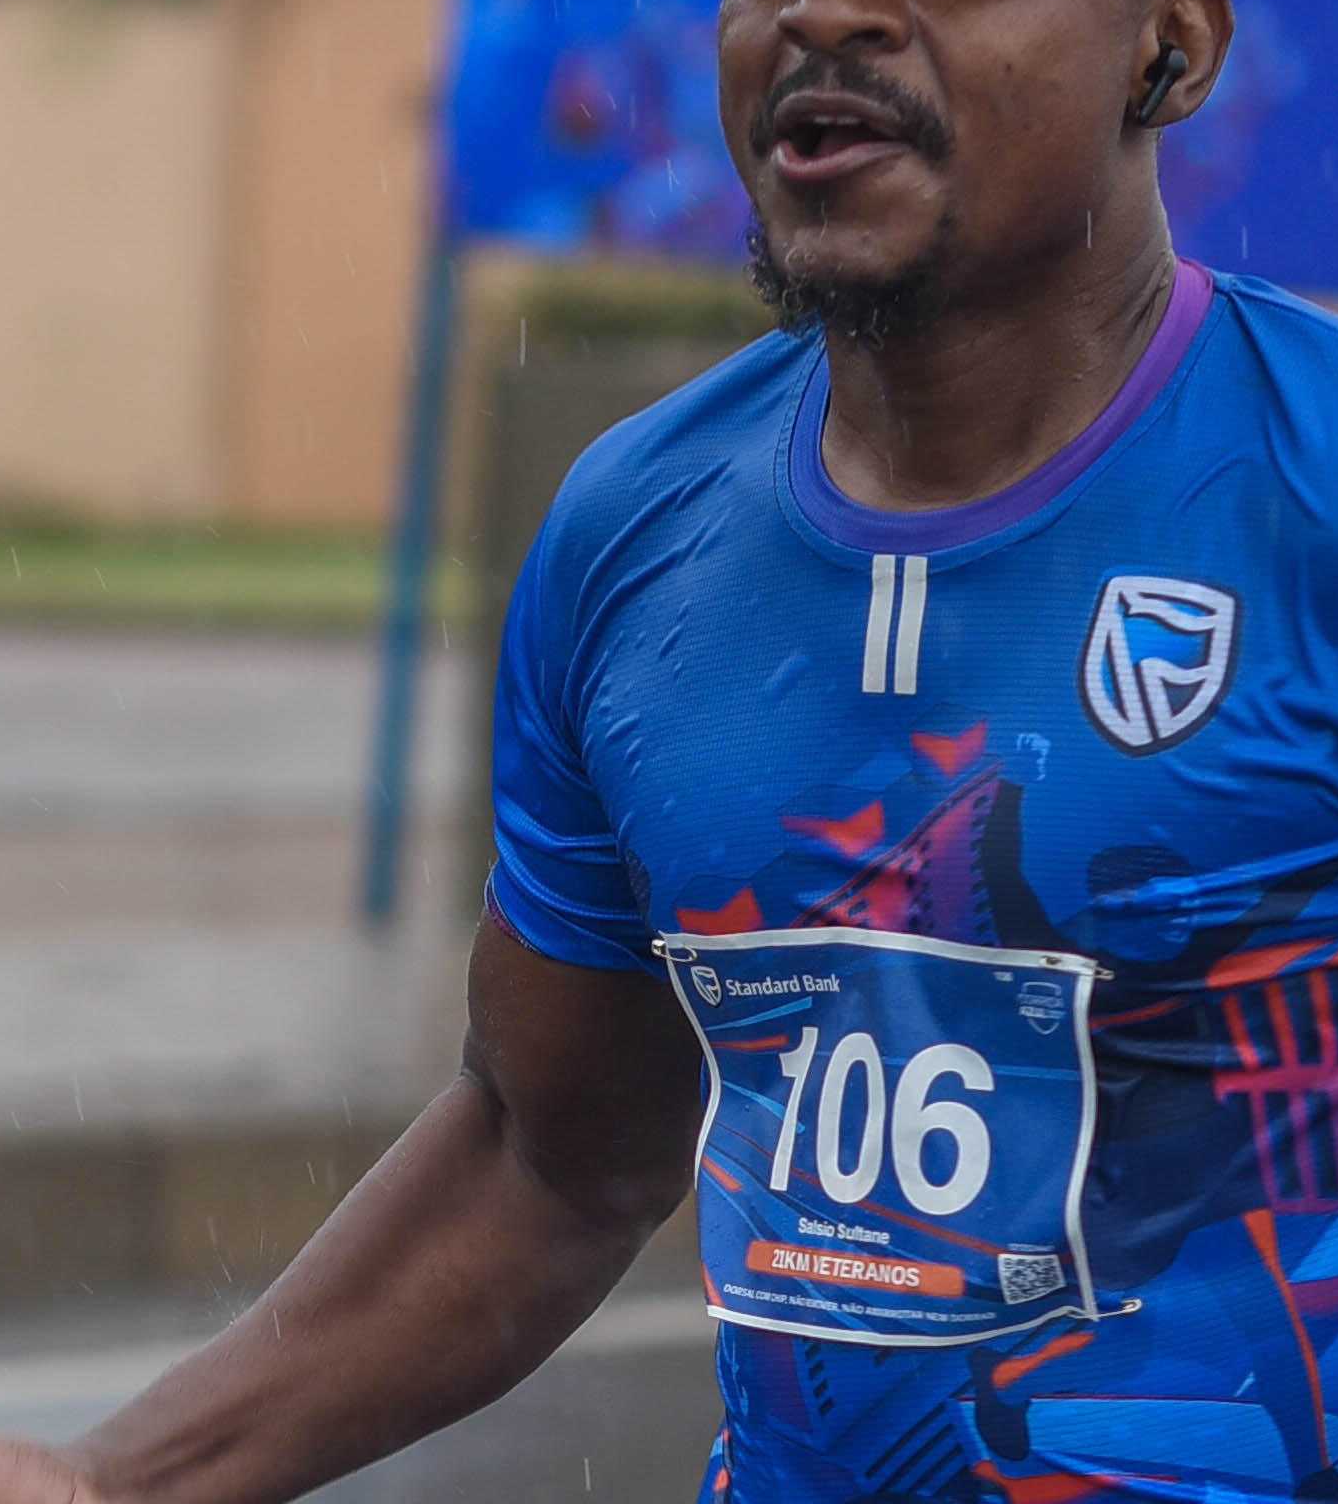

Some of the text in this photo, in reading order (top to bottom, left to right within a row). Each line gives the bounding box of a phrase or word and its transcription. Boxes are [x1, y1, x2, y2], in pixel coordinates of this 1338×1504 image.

[725, 973, 840, 996] Standard Bank
[769, 1026, 995, 1216] 106
[771, 1248, 921, 1287] 21KM VETERANOS
